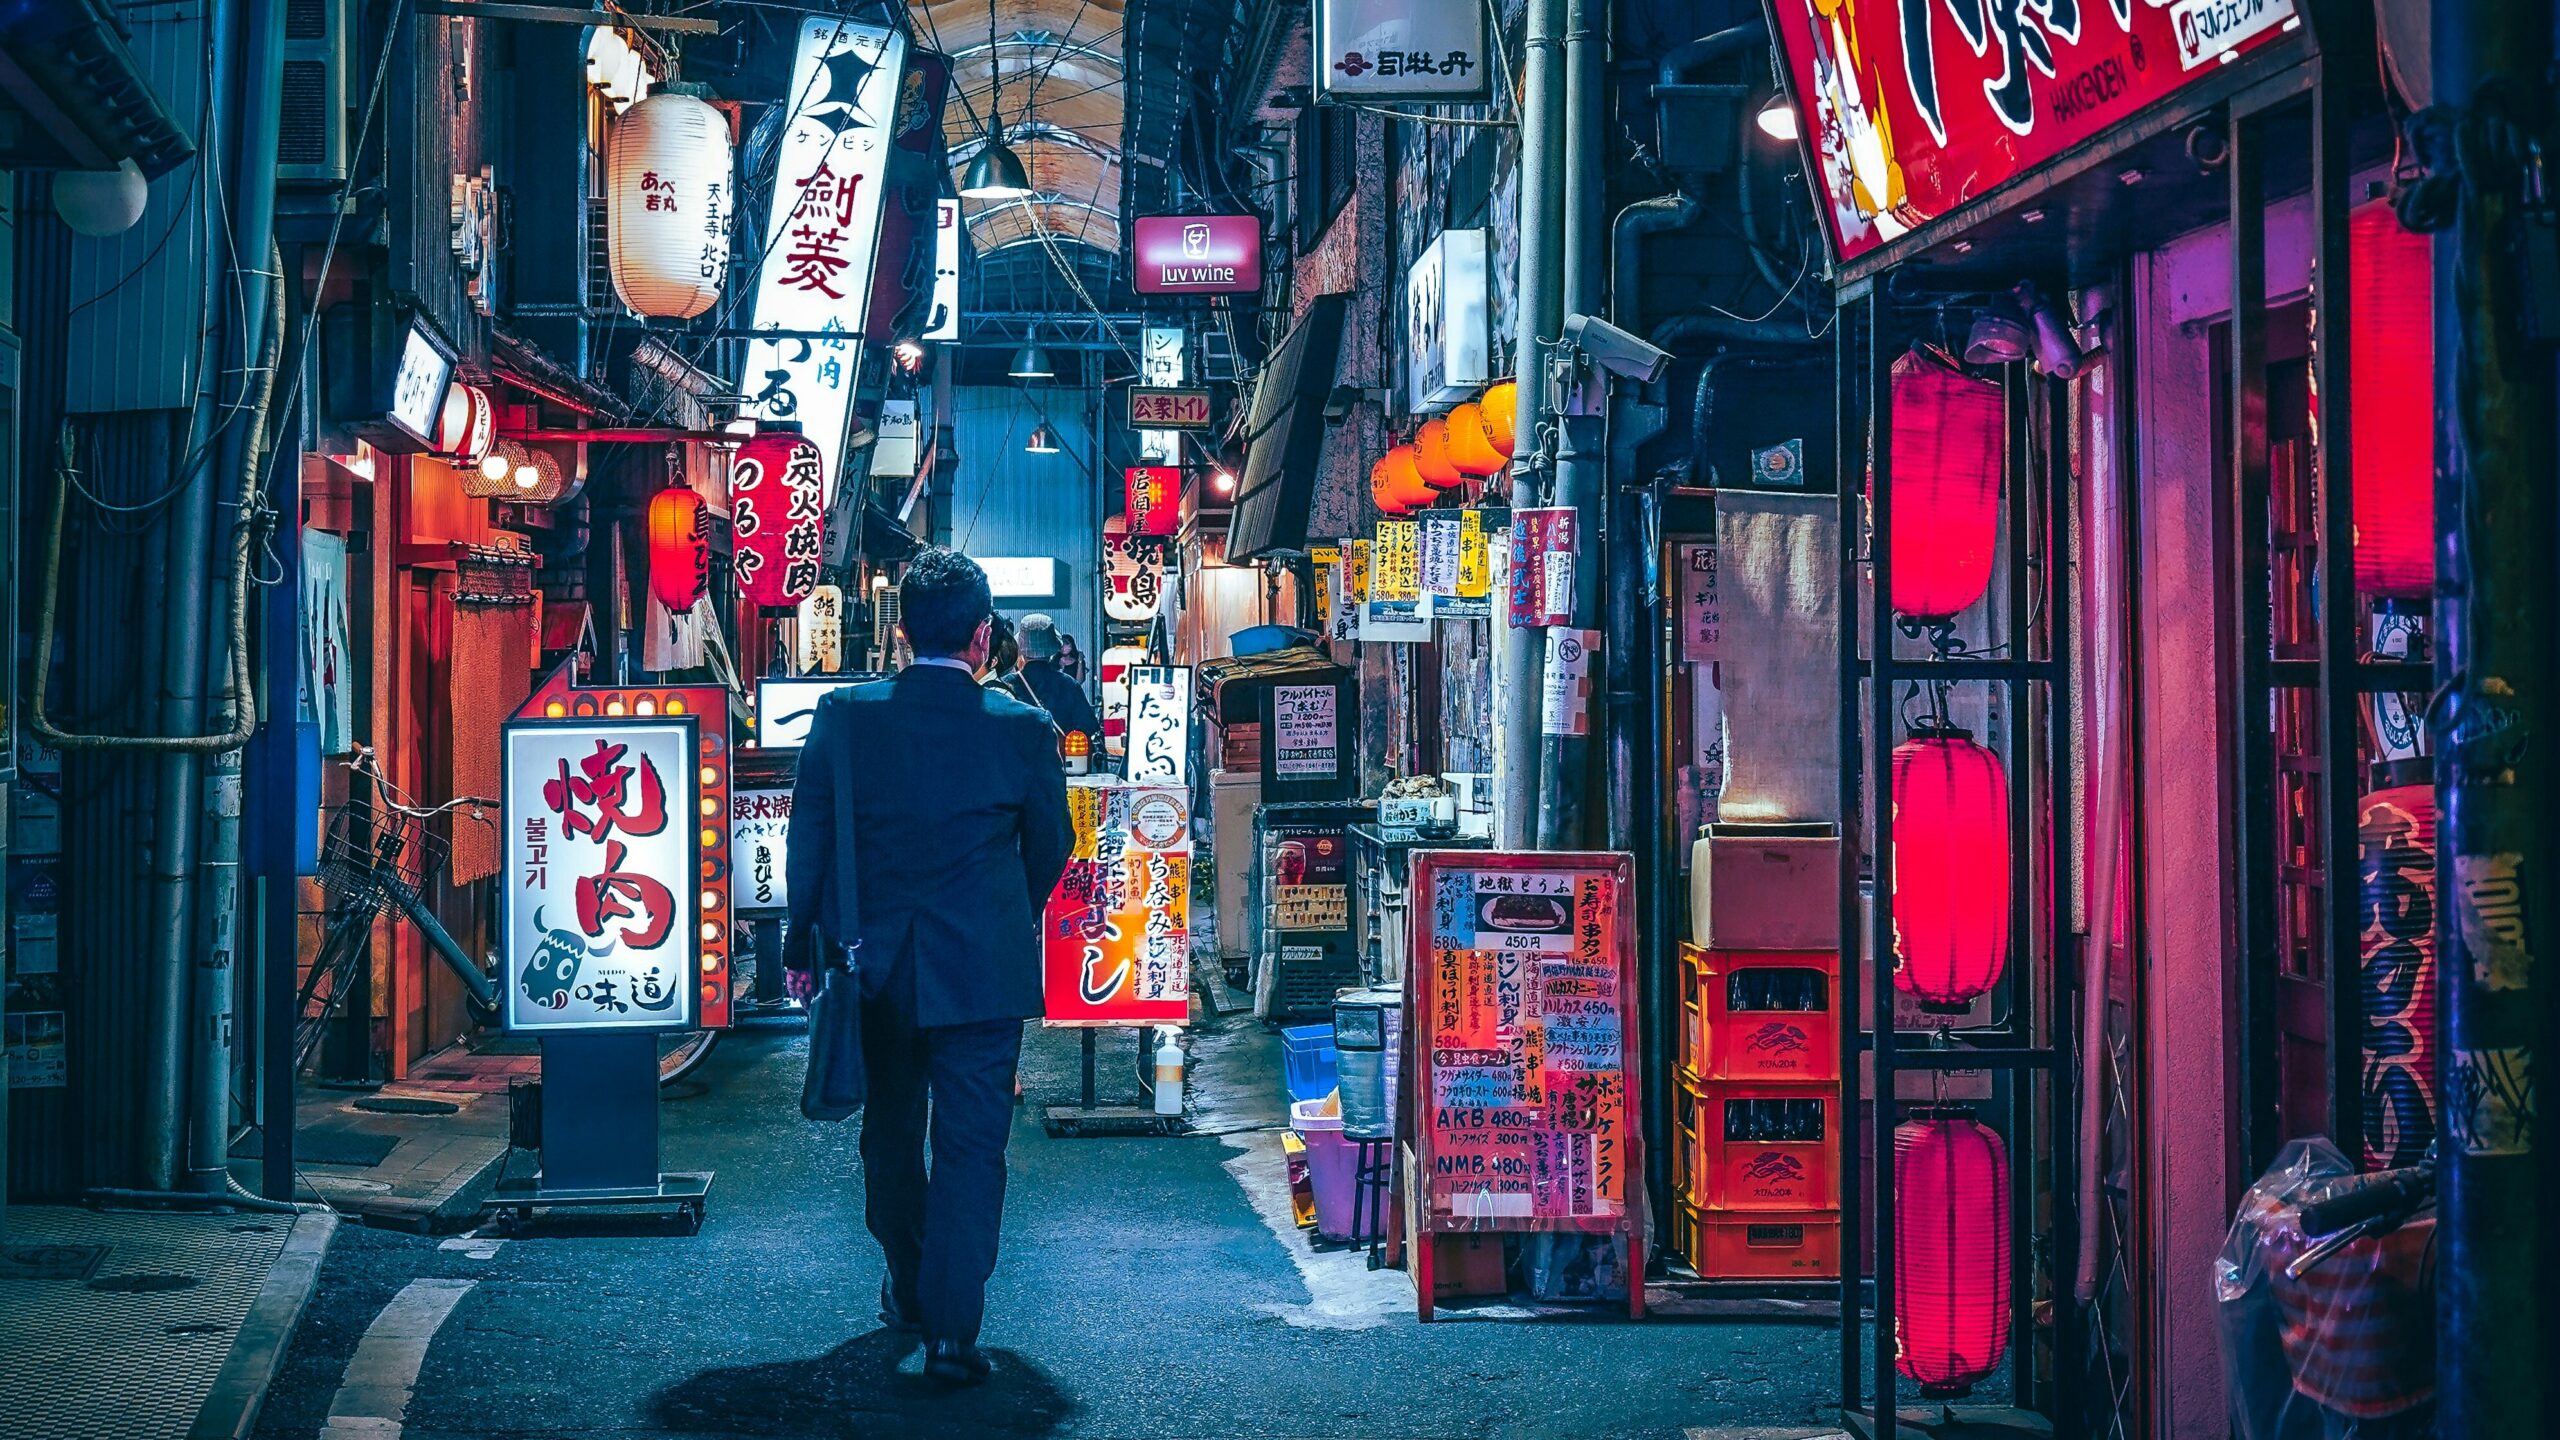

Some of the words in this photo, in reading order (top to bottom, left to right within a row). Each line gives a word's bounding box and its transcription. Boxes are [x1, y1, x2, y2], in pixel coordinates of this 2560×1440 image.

[1377, 51, 1474, 76] 司牡丹
[2050, 53, 2129, 124] HAKKENDEN
[798, 129, 875, 153] ケンビシ
[640, 171, 676, 193] あべ
[645, 194, 677, 212] 若丸
[704, 184, 721, 239] 天王寺
[700, 243, 718, 279] 北口
[1161, 264, 1188, 282] luv
[1191, 264, 1235, 282] wine
[881, 413, 913, 427] 宇和島
[1134, 396, 1209, 421] 公衆トイレ
[781, 443, 821, 597] 炭火焼肉
[525, 817, 548, 890] 불고기
[543, 739, 676, 950] 焼肉
[1169, 863, 1184, 928] 熊串焼
[1479, 875, 1570, 893] 地獄どうふ
[1579, 879, 1602, 957] お寿司串カツ
[1434, 935, 1462, 949] 580円
[1505, 936, 1541, 949] 450円
[575, 966, 677, 1014] 味道
[1439, 950, 1460, 1031] 真ほっけ刺身
[1483, 952, 1495, 1007] 北海道直送
[1497, 952, 1520, 1027] にしん刺身
[1525, 952, 1541, 1018] 北海道直送
[1543, 1000, 1582, 1015] ハルカス
[1583, 1001, 1615, 1015] 450円
[1435, 1035, 1467, 1049] 580円
[1526, 1030, 1543, 1104] 熊串焼
[1757, 1060, 1797, 1069] 大びん20本
[1437, 1107, 1485, 1129] AKB
[1491, 1109, 1531, 1128] 480円
[1495, 1132, 1528, 1145] 300円
[1597, 1077, 1614, 1196] ホッケフライ
[1437, 1155, 1486, 1175] NMB
[1753, 1188, 1793, 1197] 大びん20本
